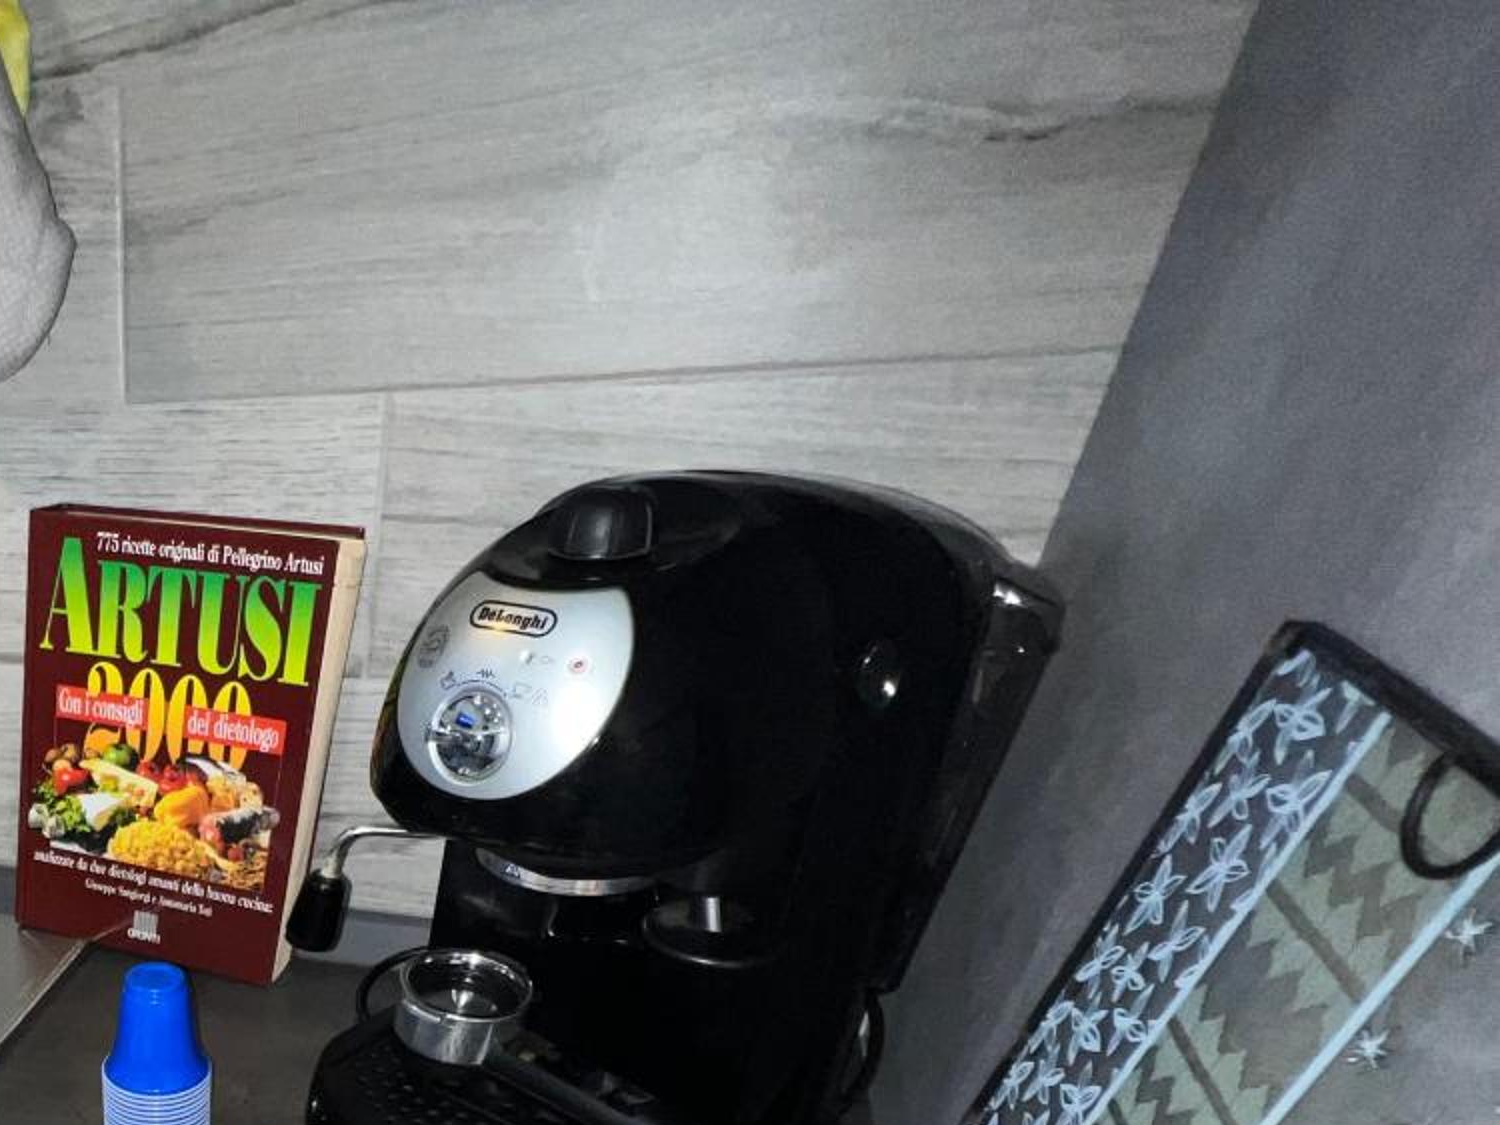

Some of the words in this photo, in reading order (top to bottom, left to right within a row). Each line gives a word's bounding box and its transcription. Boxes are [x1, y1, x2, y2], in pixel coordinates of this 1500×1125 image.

[97, 532, 119, 552] 775
[121, 535, 156, 556] ricette
[158, 540, 204, 563] originali
[207, 544, 219, 563] di
[223, 545, 282, 572] Pellegrino
[284, 552, 324, 575] Artusi
[40, 537, 321, 686] ARTUSI
[59, 687, 80, 715] Con
[92, 698, 143, 728] consigli
[213, 714, 279, 753] dietologo
